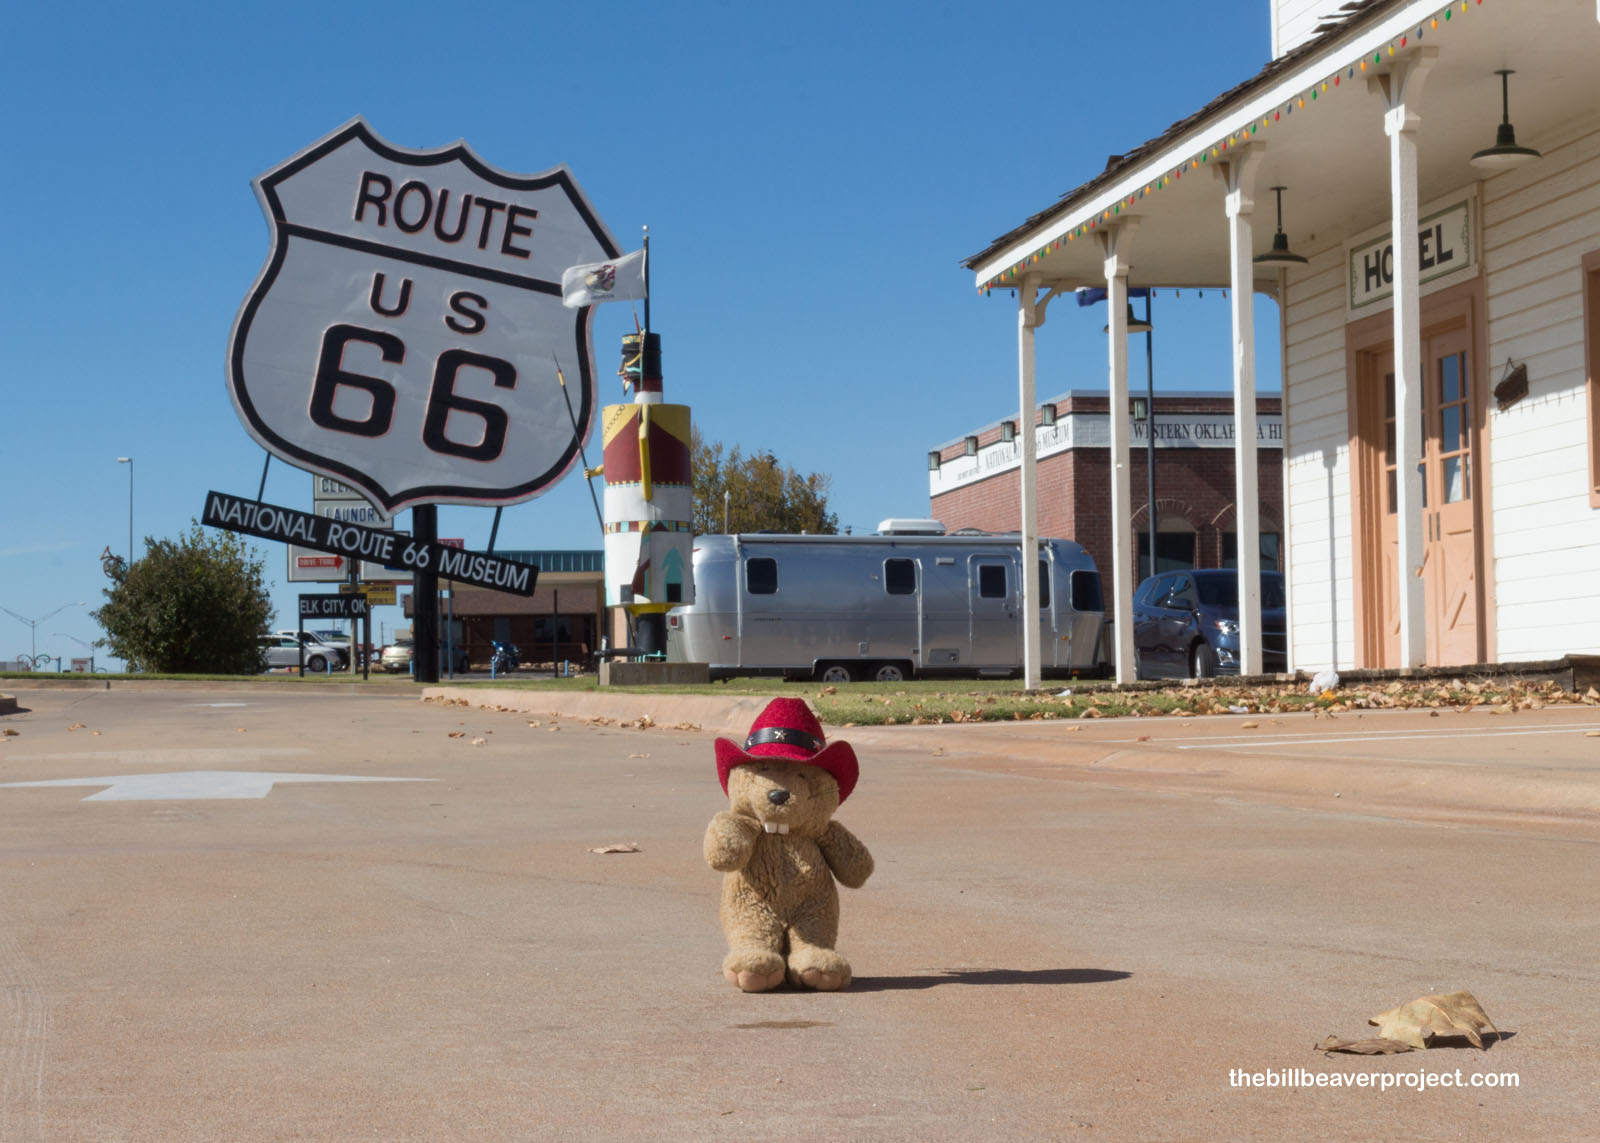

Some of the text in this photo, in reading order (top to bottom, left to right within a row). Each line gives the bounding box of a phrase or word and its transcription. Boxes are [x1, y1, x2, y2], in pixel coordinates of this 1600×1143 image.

[354, 171, 538, 259] ROUTE
[1364, 224, 1453, 292] HOEL
[369, 272, 488, 334] U S
[309, 324, 517, 462] 66
[1194, 423, 1265, 440] OKLAHA
[209, 495, 530, 591] NATIONAL ROUTE 66 MUSEUM
[300, 600, 319, 614] ELK
[322, 600, 348, 616] CITY,
[351, 600, 367, 614] OK
